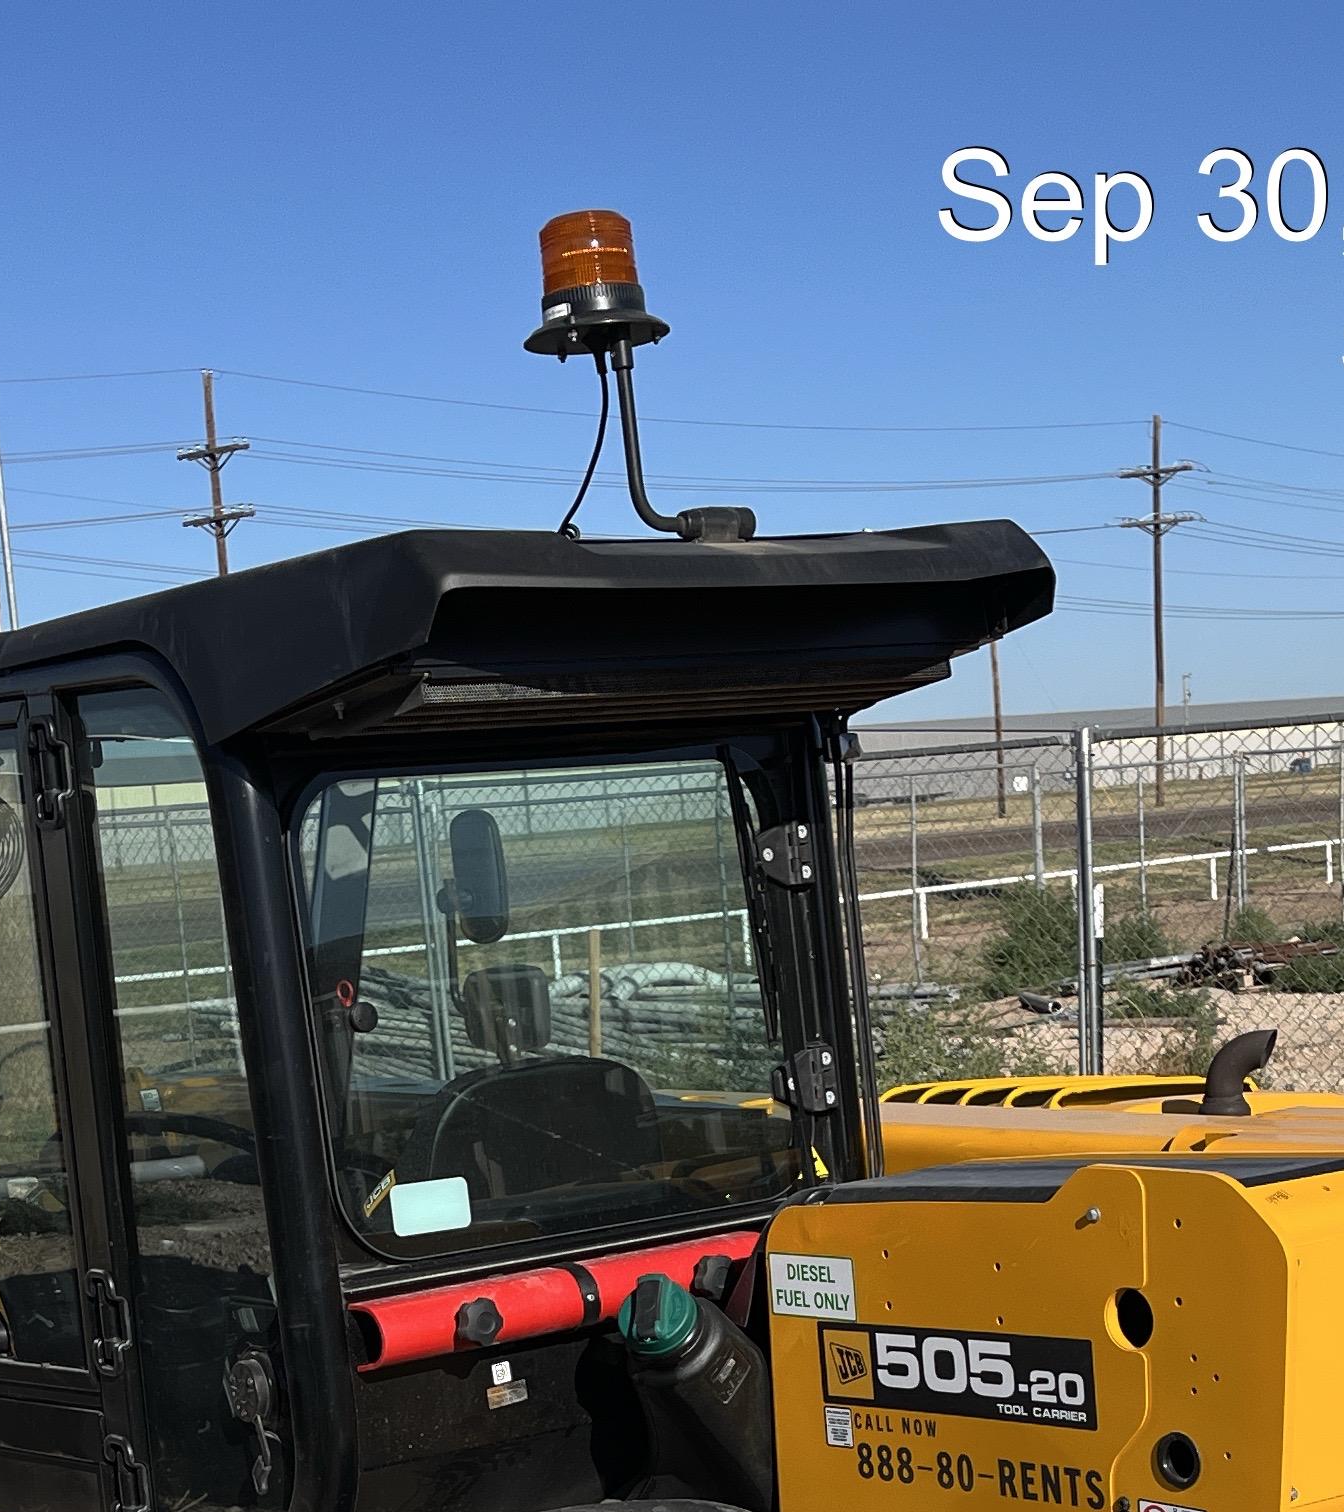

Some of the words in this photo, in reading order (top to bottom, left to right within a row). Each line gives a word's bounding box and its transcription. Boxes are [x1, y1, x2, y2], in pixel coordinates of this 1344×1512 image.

[366, 1176, 391, 1208] JCB
[786, 1263, 836, 1284] DIESEL
[775, 1288, 811, 1308] FUEL
[814, 1291, 850, 1311] ONLY
[835, 1347, 864, 1380] JCB
[854, 1412, 894, 1433] CALL
[902, 1418, 937, 1438] NOW
[997, 1403, 1028, 1417] TOOL
[1032, 1406, 1087, 1422] CARRIER
[857, 1442, 1106, 1510] 888-80-RENTS
